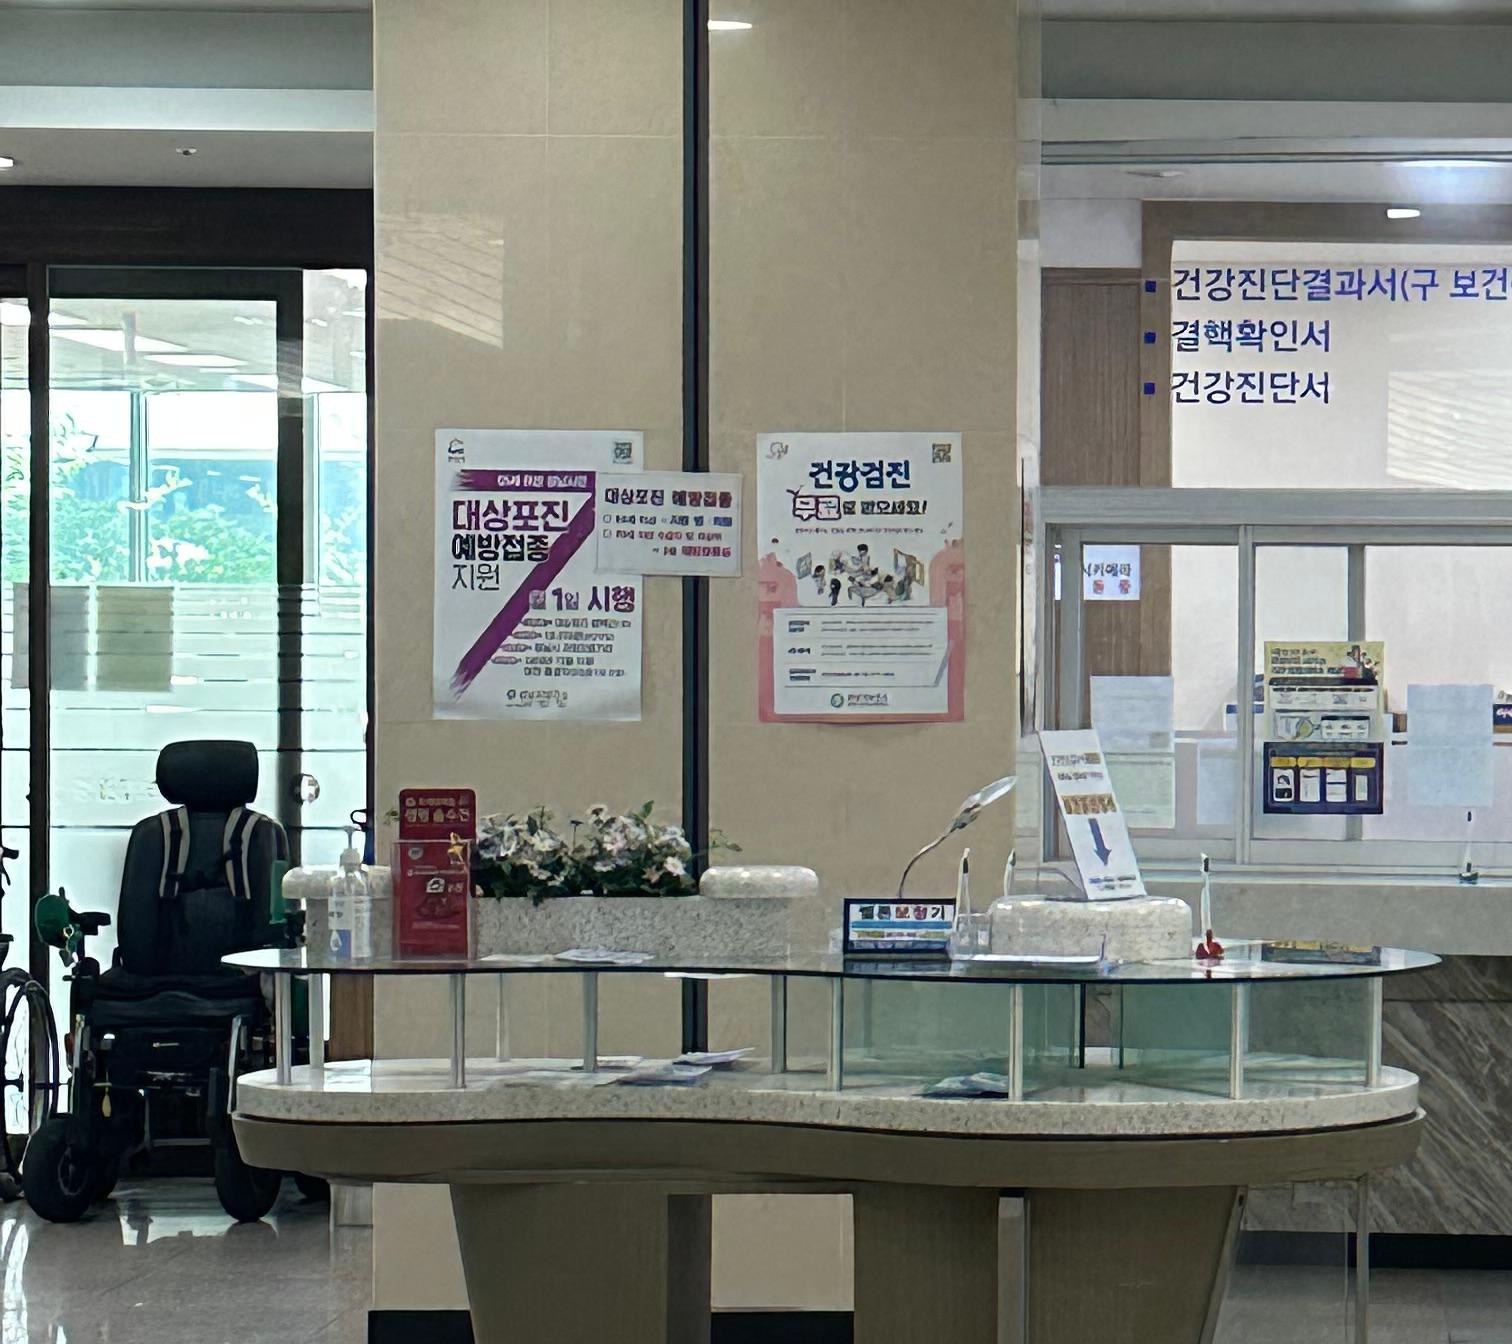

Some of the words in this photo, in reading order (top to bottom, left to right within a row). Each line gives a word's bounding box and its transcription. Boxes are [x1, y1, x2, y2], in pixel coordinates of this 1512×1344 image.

[1171, 267, 1440, 304] 건강진단결과서(구
[1171, 319, 1331, 354] 결핵확인서
[1170, 370, 1331, 404] 건강진단서
[808, 460, 911, 493] 건강검진
[452, 500, 570, 532] 대상포진
[451, 533, 550, 562] 예방접종
[452, 563, 500, 591] 지원
[551, 587, 580, 611] 1일
[587, 585, 636, 613] 시행
